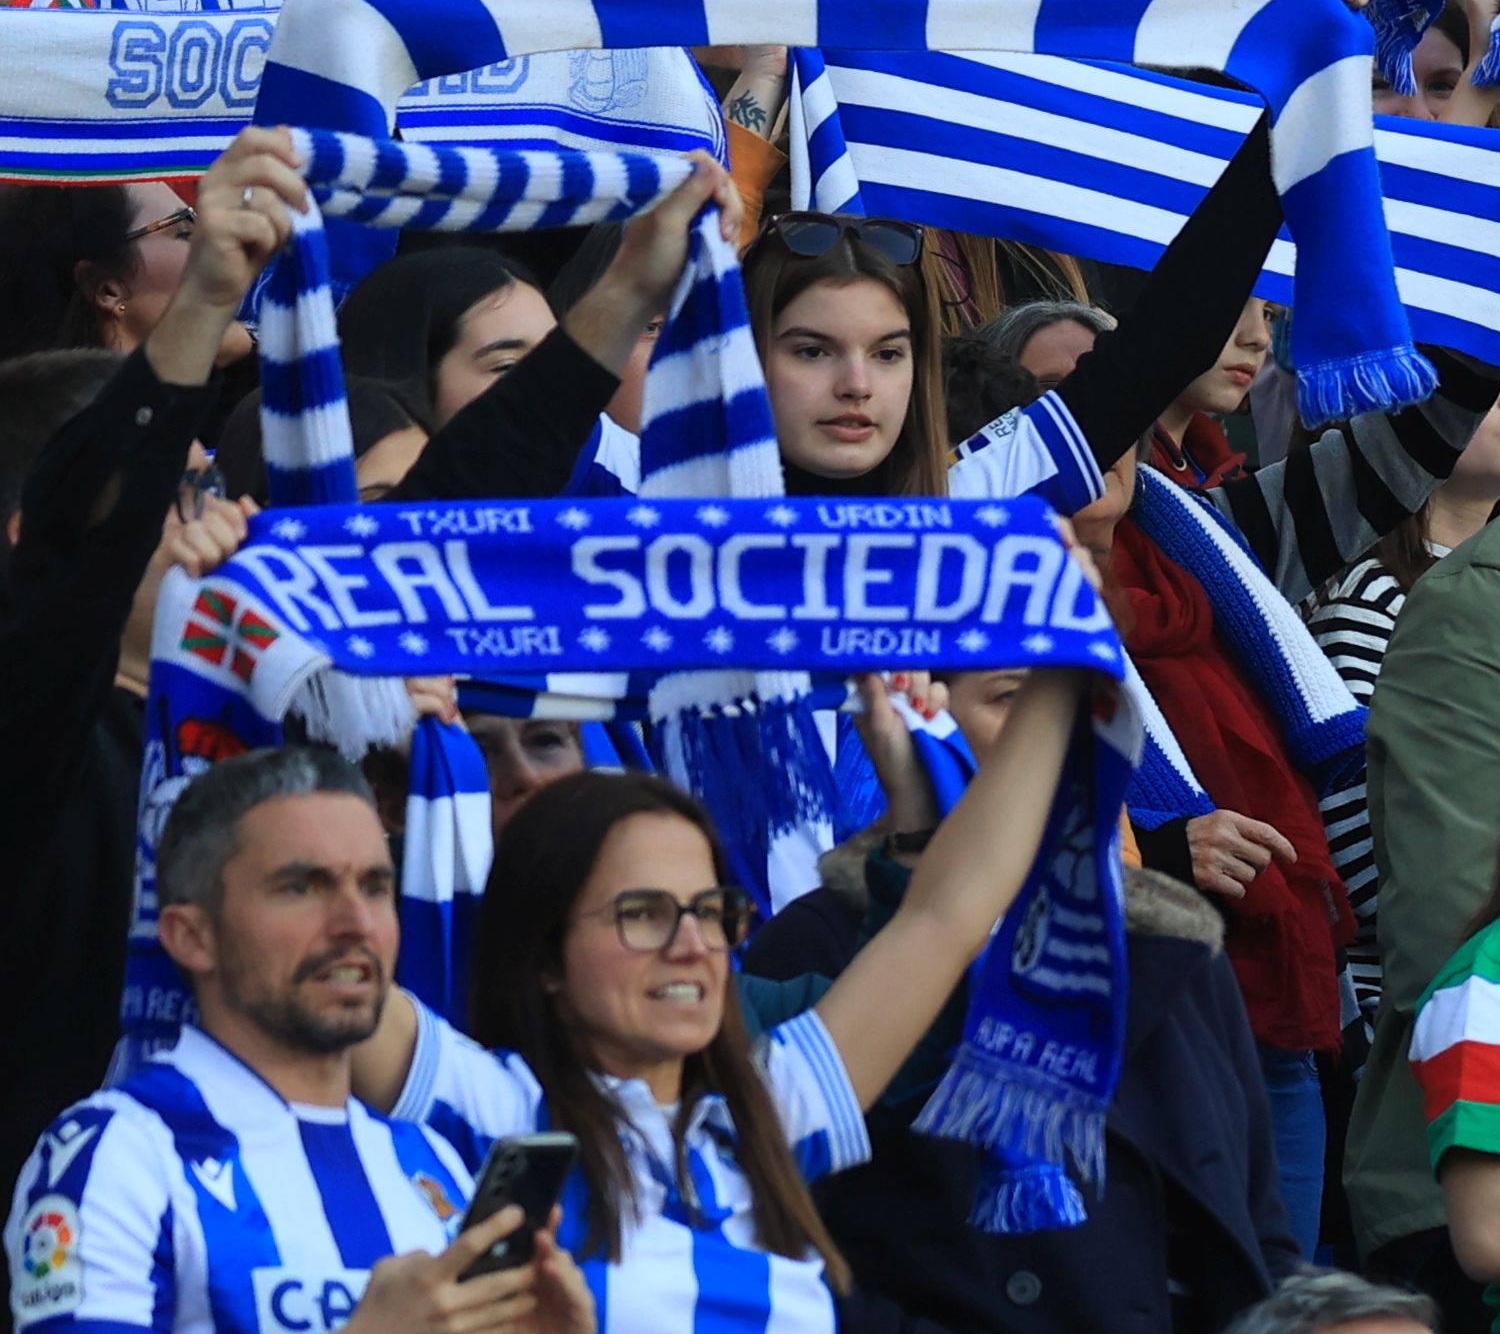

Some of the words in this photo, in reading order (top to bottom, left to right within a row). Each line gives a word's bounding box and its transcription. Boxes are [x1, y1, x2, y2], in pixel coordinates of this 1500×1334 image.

[400, 508, 533, 536] TXURI
[818, 503, 952, 529] URDIN
[245, 542, 533, 630] REAL
[572, 533, 1108, 630] SOCIEDAD
[446, 628, 560, 656] TXURI
[822, 628, 940, 656] URDIN
